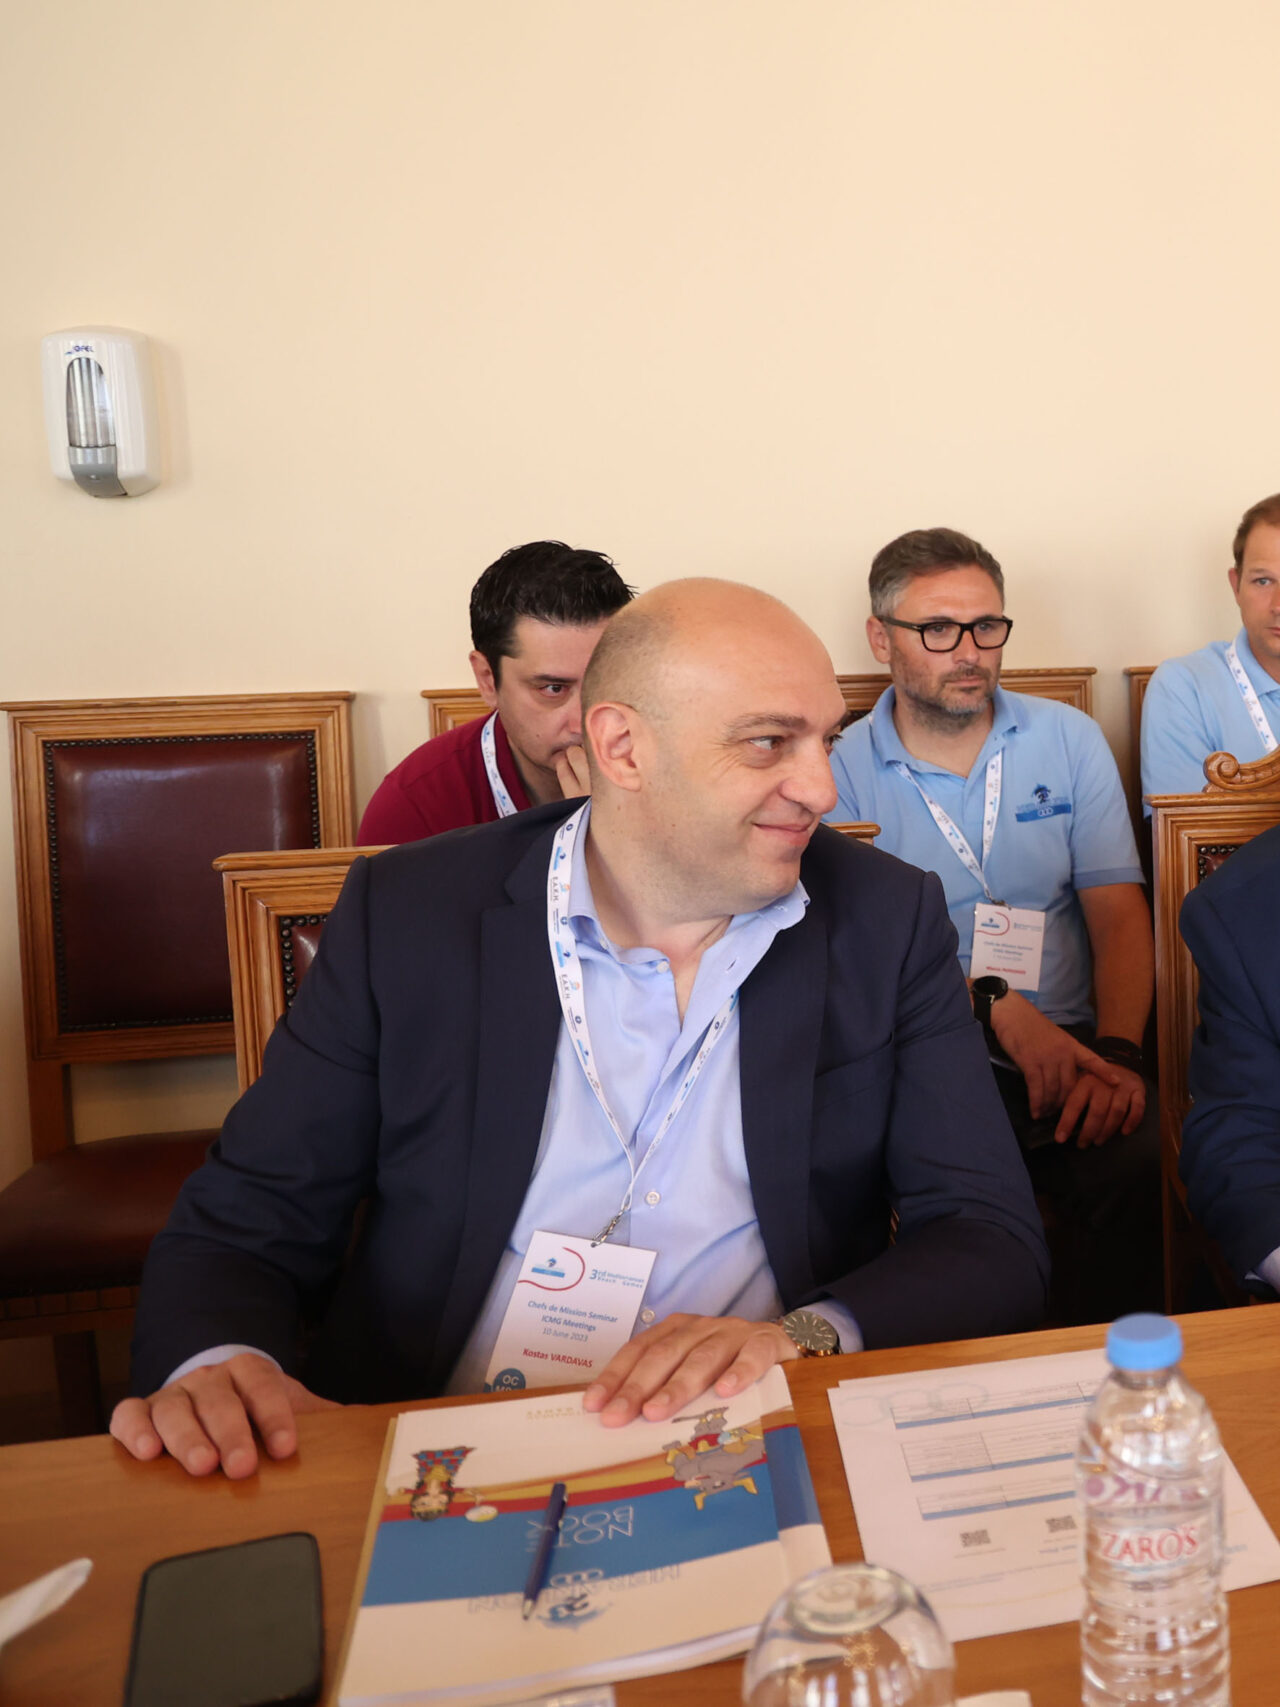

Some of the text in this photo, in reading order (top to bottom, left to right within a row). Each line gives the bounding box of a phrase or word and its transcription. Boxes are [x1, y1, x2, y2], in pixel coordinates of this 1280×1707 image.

[528, 1300, 618, 1322] Chefs de Mission Seminar
[541, 1315, 596, 1332] ICMG Meetings
[543, 1327, 552, 1336] 10
[553, 1329, 569, 1338] June
[522, 1348, 593, 1368] Kostas VARDAVAS
[502, 1374, 520, 1386] OC
[467, 1564, 682, 1614] HERAKLON
